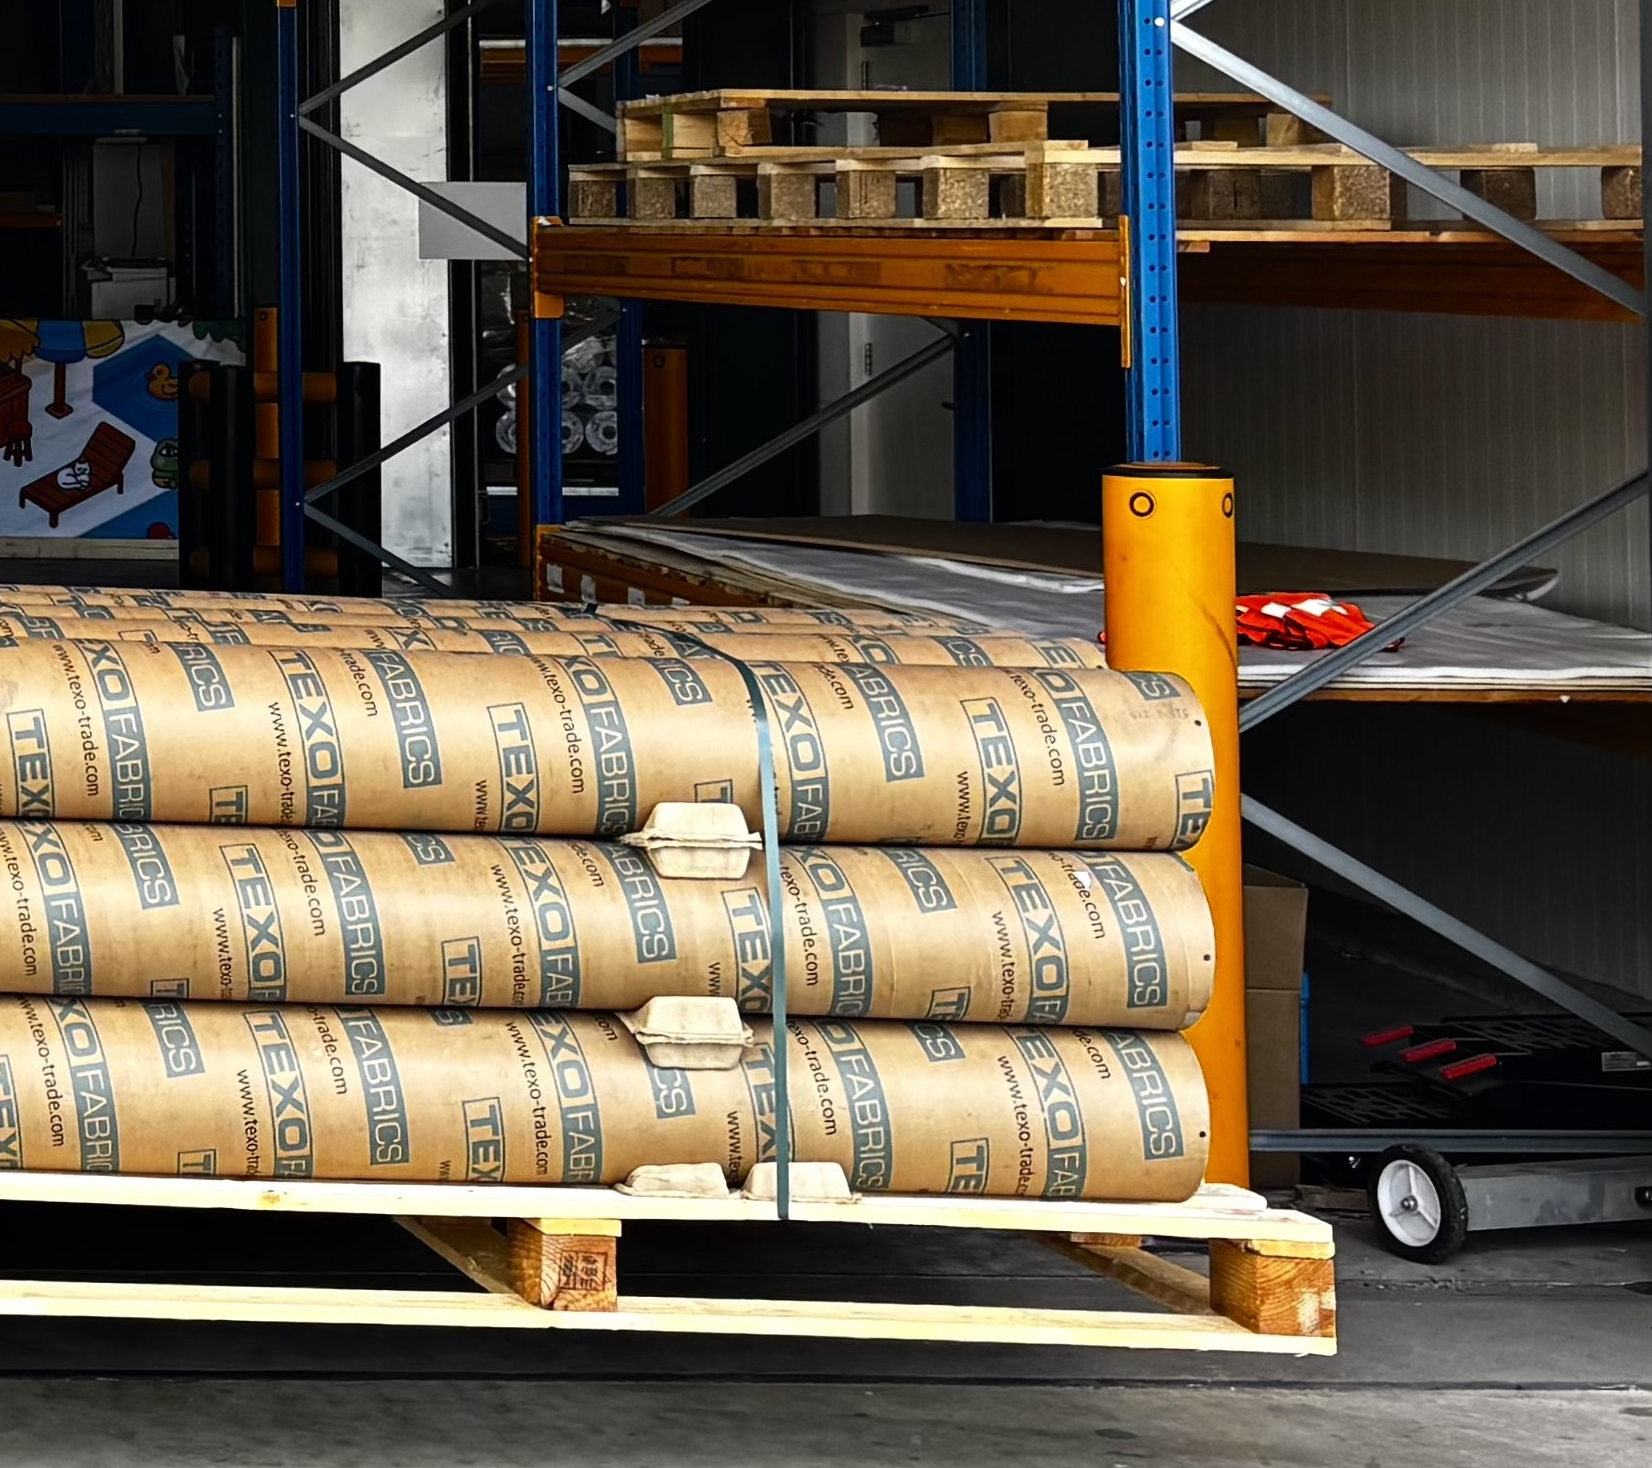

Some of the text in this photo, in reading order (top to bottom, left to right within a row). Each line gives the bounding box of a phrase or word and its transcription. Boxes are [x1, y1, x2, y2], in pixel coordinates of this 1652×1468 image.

[377, 651, 435, 784] FABRICS
[495, 707, 537, 831] TEXO
[853, 665, 915, 777] ABRICS
[972, 703, 1018, 837] TEXO
[1063, 703, 1110, 839] FABRICS
[230, 849, 284, 980] TEXO
[332, 851, 379, 994] FABRICS
[510, 843, 574, 939] EXO
[612, 846, 668, 958] ABRICS
[999, 859, 1064, 991] TEXO
[1098, 854, 1161, 1006] FABRICS
[253, 1013, 308, 1150] TEXO
[349, 1019, 401, 1162] FABRICS
[470, 1103, 500, 1182] TEX
[1023, 1034, 1080, 1140] EXO
[1113, 1032, 1177, 1156] ABRICS
